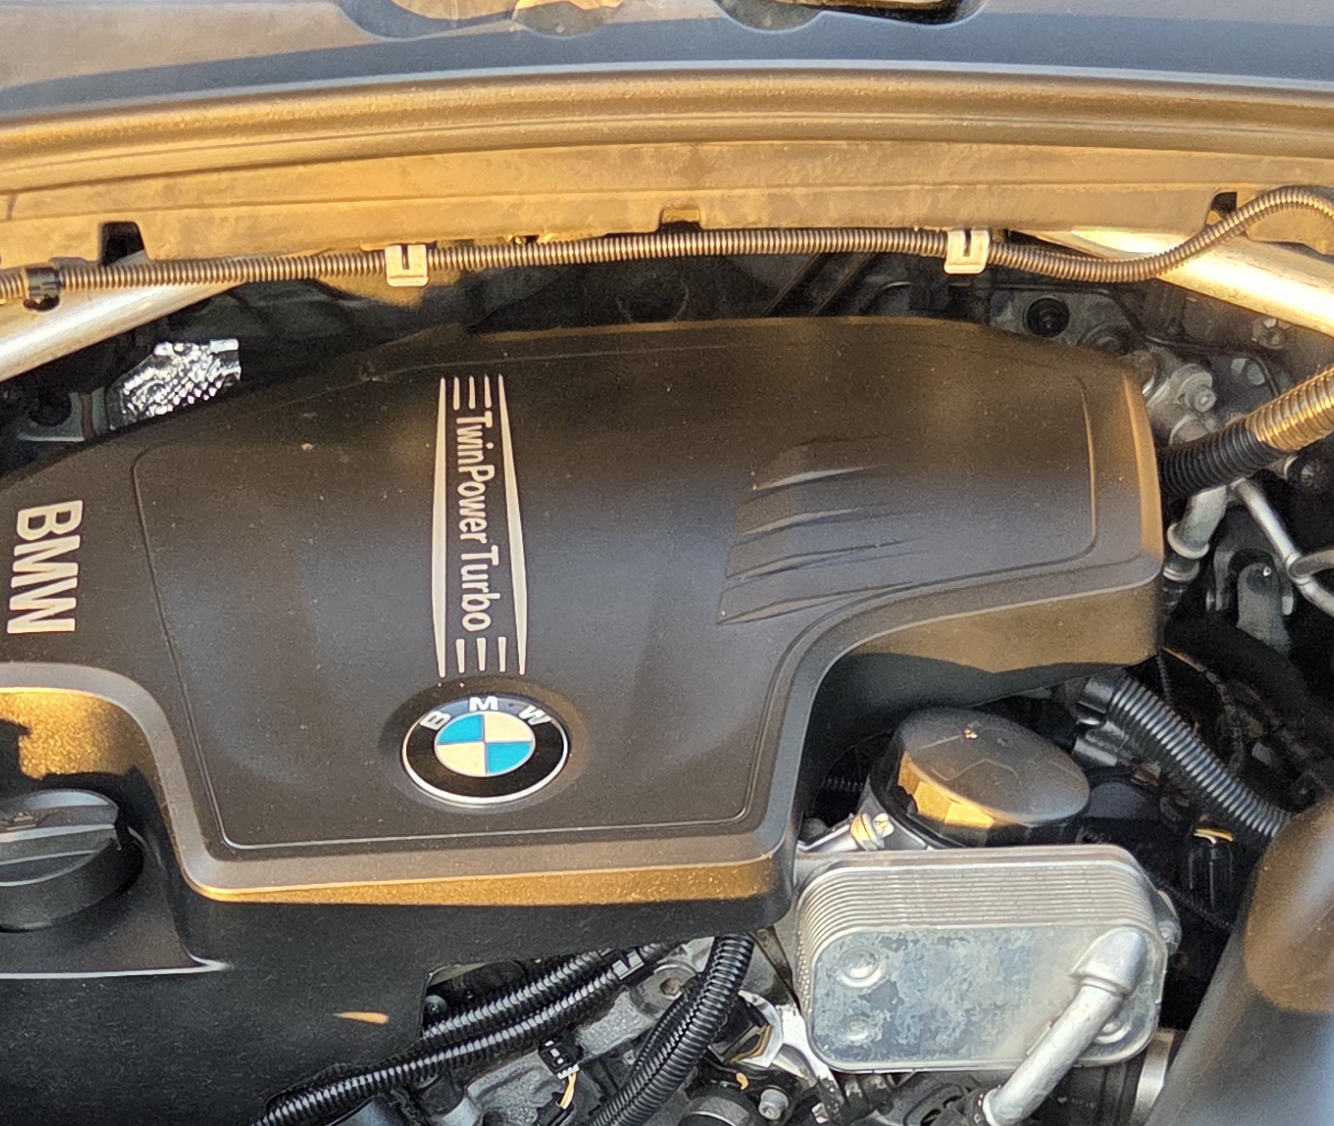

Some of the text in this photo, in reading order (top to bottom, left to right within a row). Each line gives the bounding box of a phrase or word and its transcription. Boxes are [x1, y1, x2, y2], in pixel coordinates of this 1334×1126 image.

[7, 500, 83, 634] BMW
[455, 410, 502, 632] TwinPower Turbo
[419, 696, 552, 731] BMW
